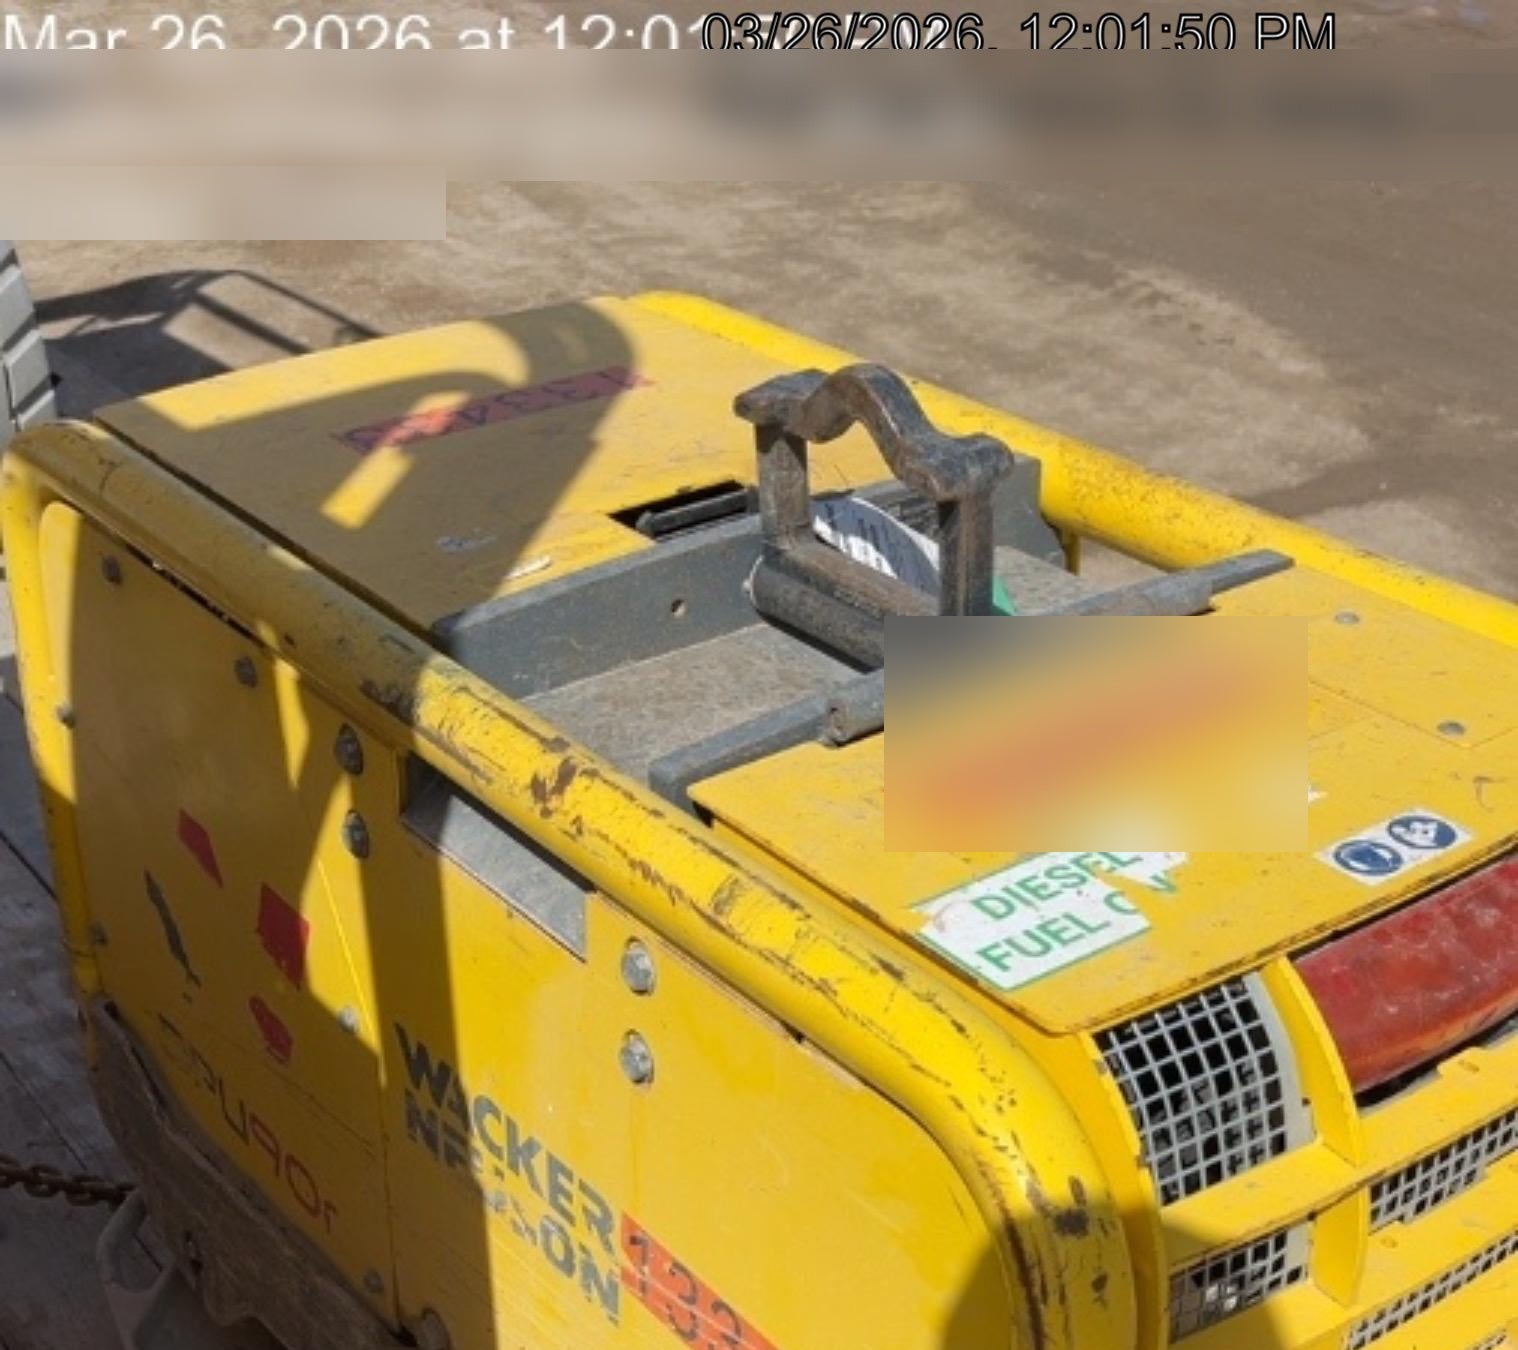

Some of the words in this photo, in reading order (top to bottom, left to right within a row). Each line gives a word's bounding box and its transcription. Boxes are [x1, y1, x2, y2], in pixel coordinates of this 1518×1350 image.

[969, 851, 1143, 922] DIESEL
[976, 911, 1113, 972] FUEL
[394, 1021, 618, 1266] WACKER
[403, 1086, 620, 1326] NEON
